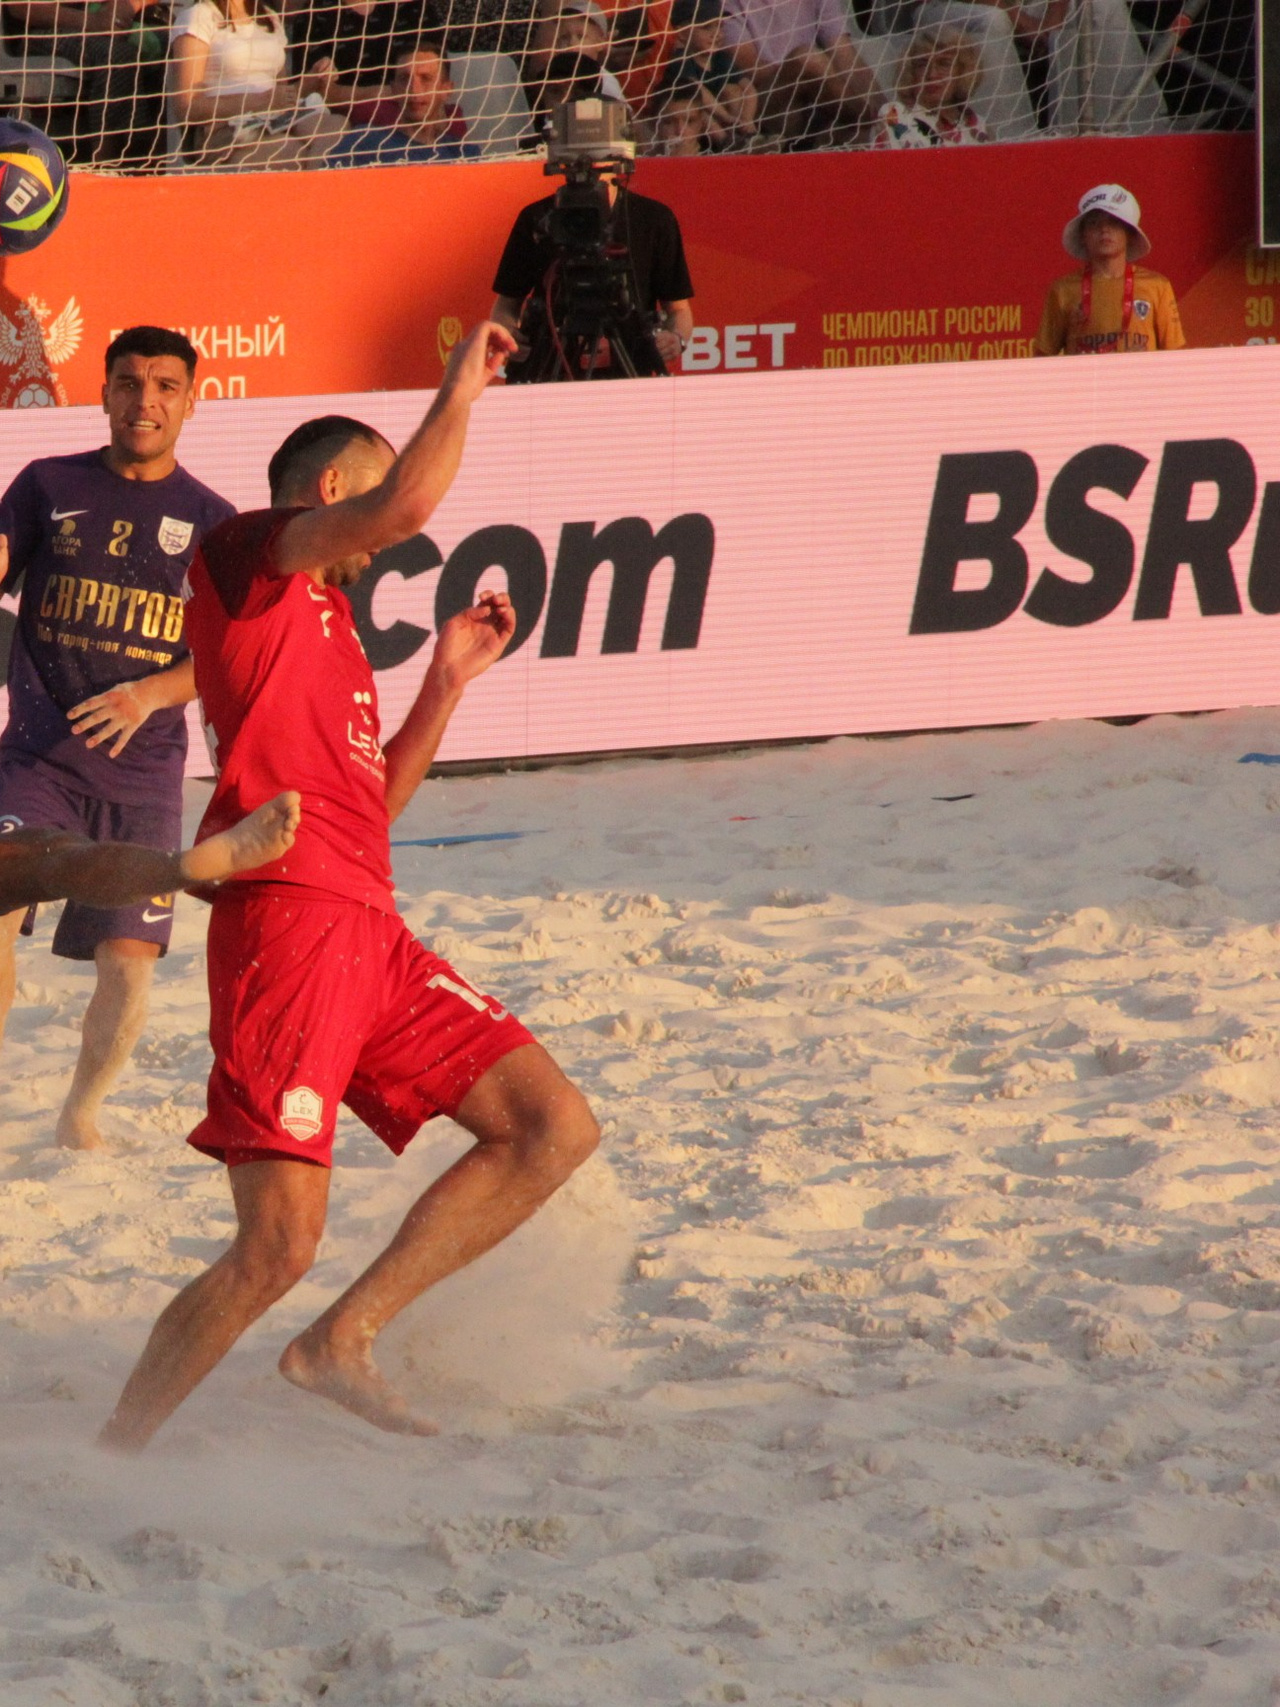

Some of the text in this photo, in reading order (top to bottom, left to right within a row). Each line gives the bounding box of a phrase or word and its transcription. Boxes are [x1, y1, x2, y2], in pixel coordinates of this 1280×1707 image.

[823, 304, 1021, 340] ЧЕМПИОНАТ РОССИИ
[108, 520, 134, 557] 2
[40, 573, 184, 643] САРАТОВ
